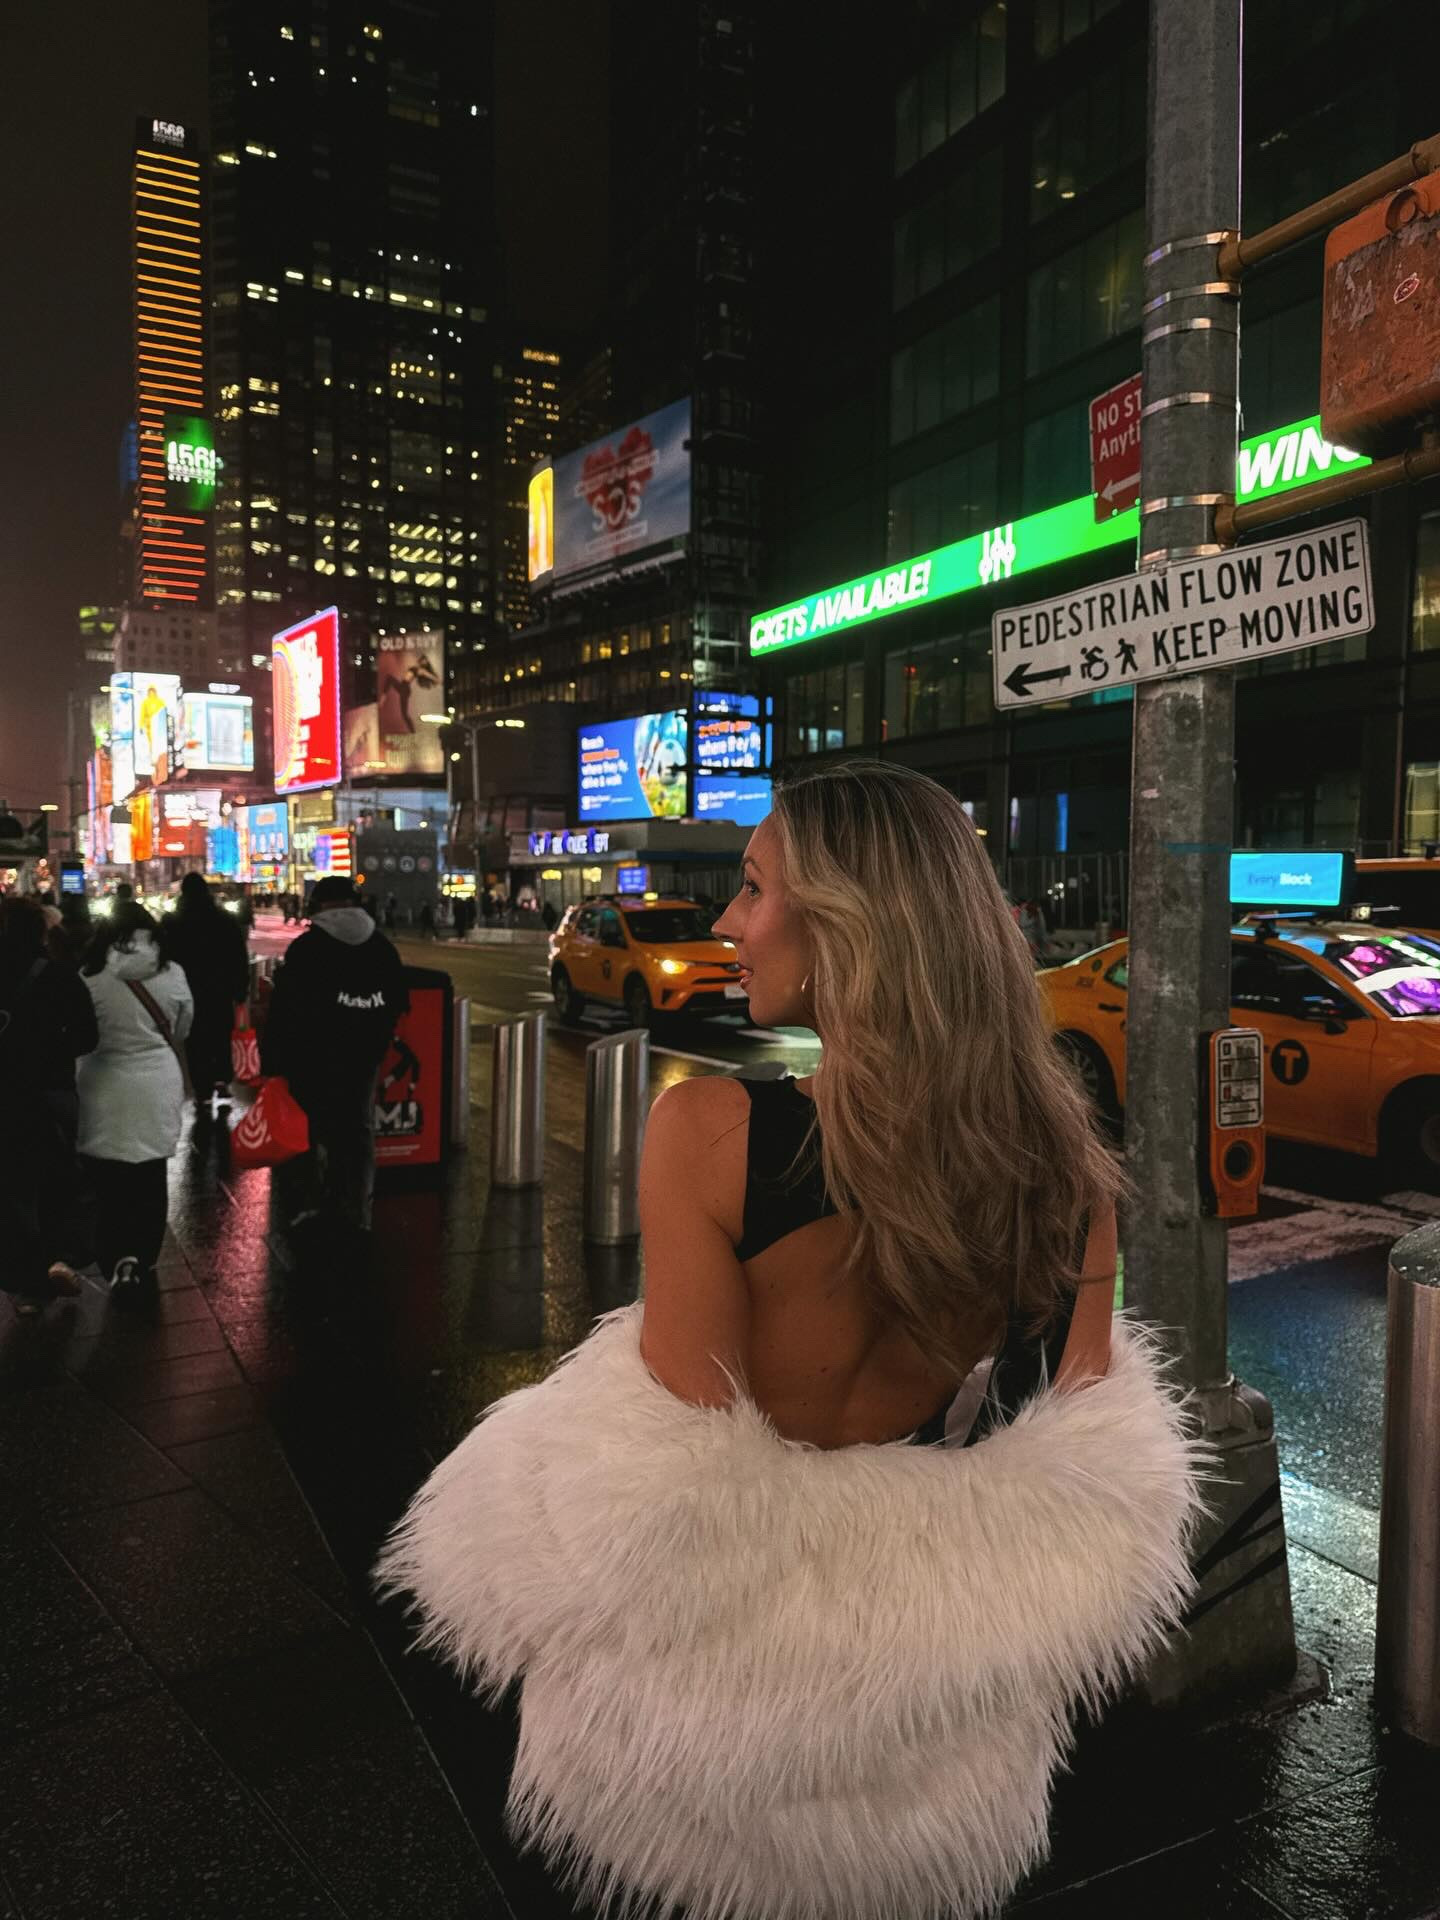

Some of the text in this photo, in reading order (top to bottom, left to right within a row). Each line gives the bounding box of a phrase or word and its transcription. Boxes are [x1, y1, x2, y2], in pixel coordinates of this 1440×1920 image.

[1097, 402, 1119, 433] NO
[1099, 419, 1141, 462] Anyti
[810, 559, 932, 633] AVAILABLE!
[1001, 531, 1361, 652] PEDESTRIAN FLOW ZONE
[1152, 585, 1363, 667] KEEP MOVING
[1279, 872, 1312, 886] Block
[1280, 1048, 1302, 1080] T
